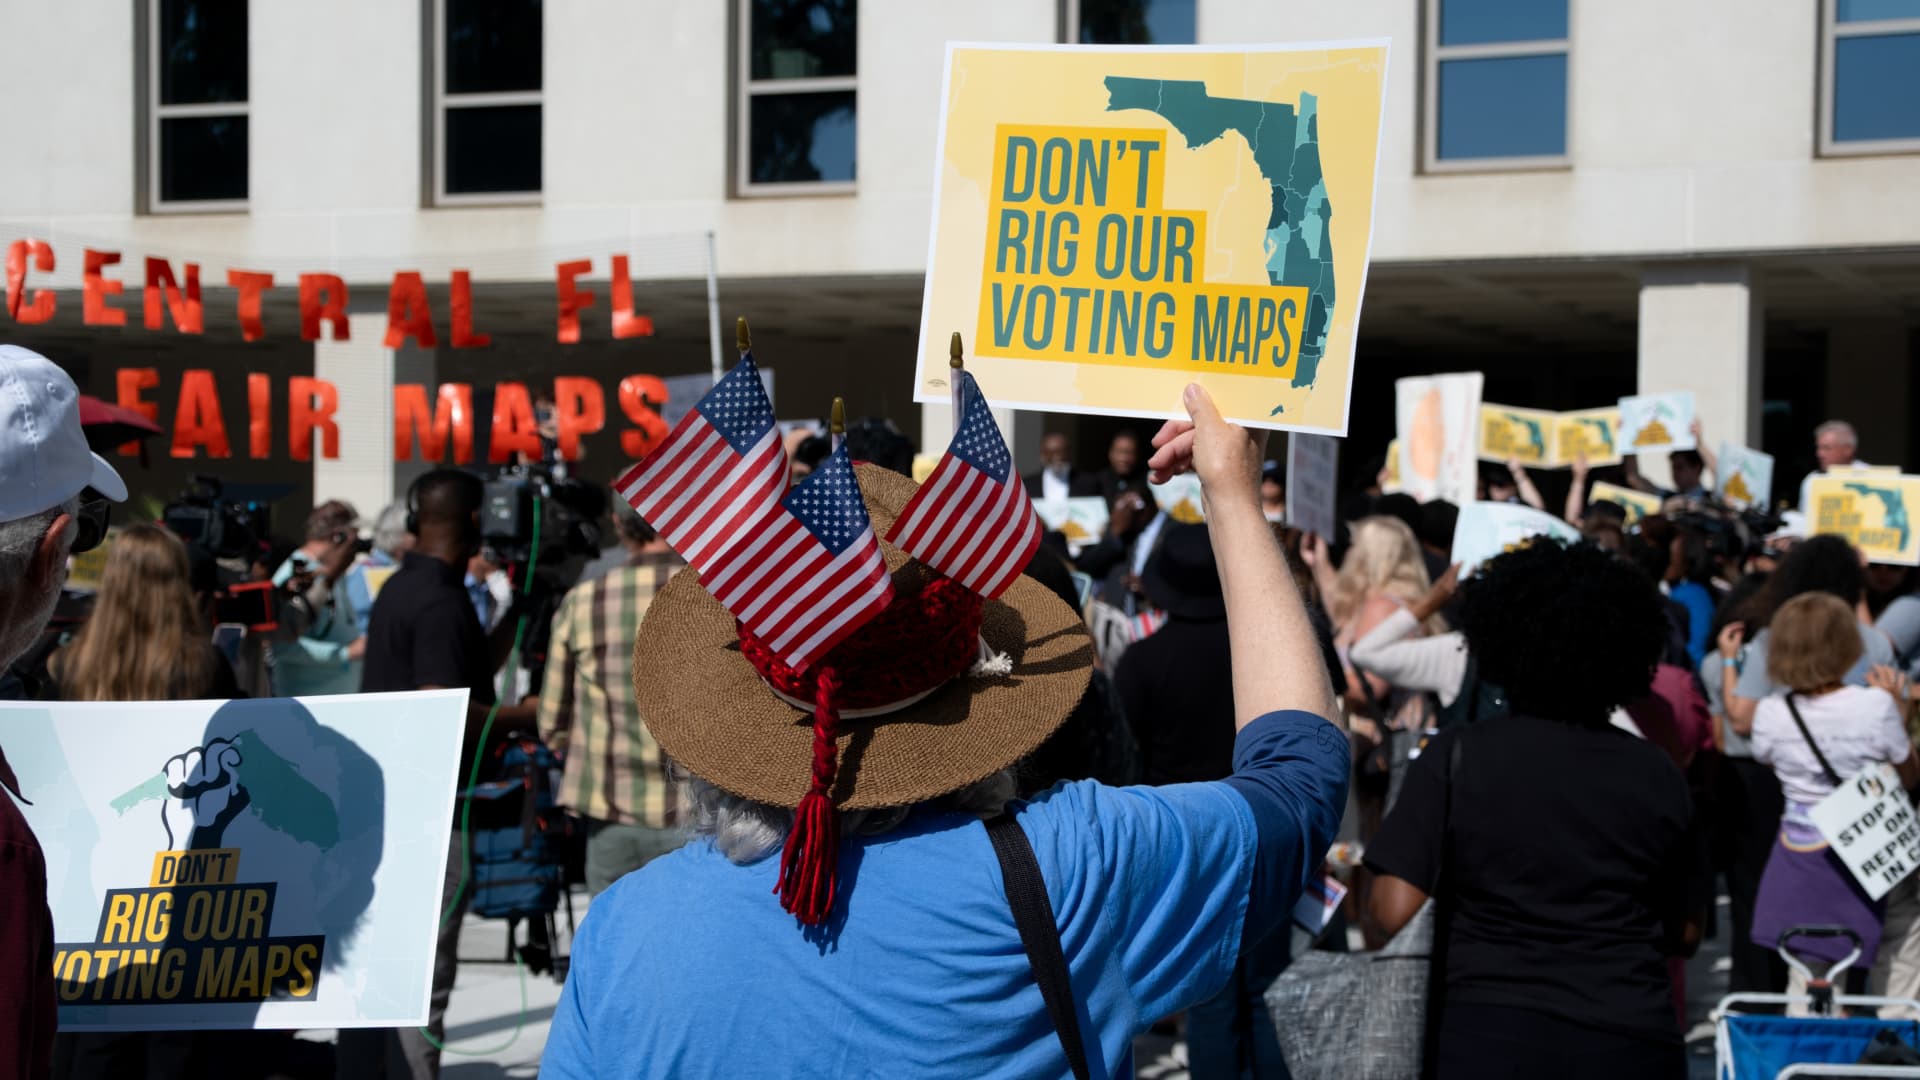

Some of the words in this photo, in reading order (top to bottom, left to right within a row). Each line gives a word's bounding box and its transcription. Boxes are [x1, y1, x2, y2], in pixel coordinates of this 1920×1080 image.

[1002, 135, 1160, 209] DON'T
[995, 208, 1081, 276] RIG
[1095, 213, 1195, 284] OUR
[5, 238, 491, 349] CENTRAL
[556, 254, 654, 344] FL
[991, 282, 1176, 359] VOTING
[1191, 293, 1297, 368] MAPS
[116, 368, 340, 459] FAIR
[394, 374, 670, 465] MAPS
[1838, 802, 1886, 848] STOP
[1884, 806, 1909, 833] ON
[159, 853, 232, 885] DON'T
[1882, 860, 1905, 884] IN
[103, 891, 174, 944] RIG
[183, 887, 269, 942] OUR
[195, 943, 318, 1000] MAPS
